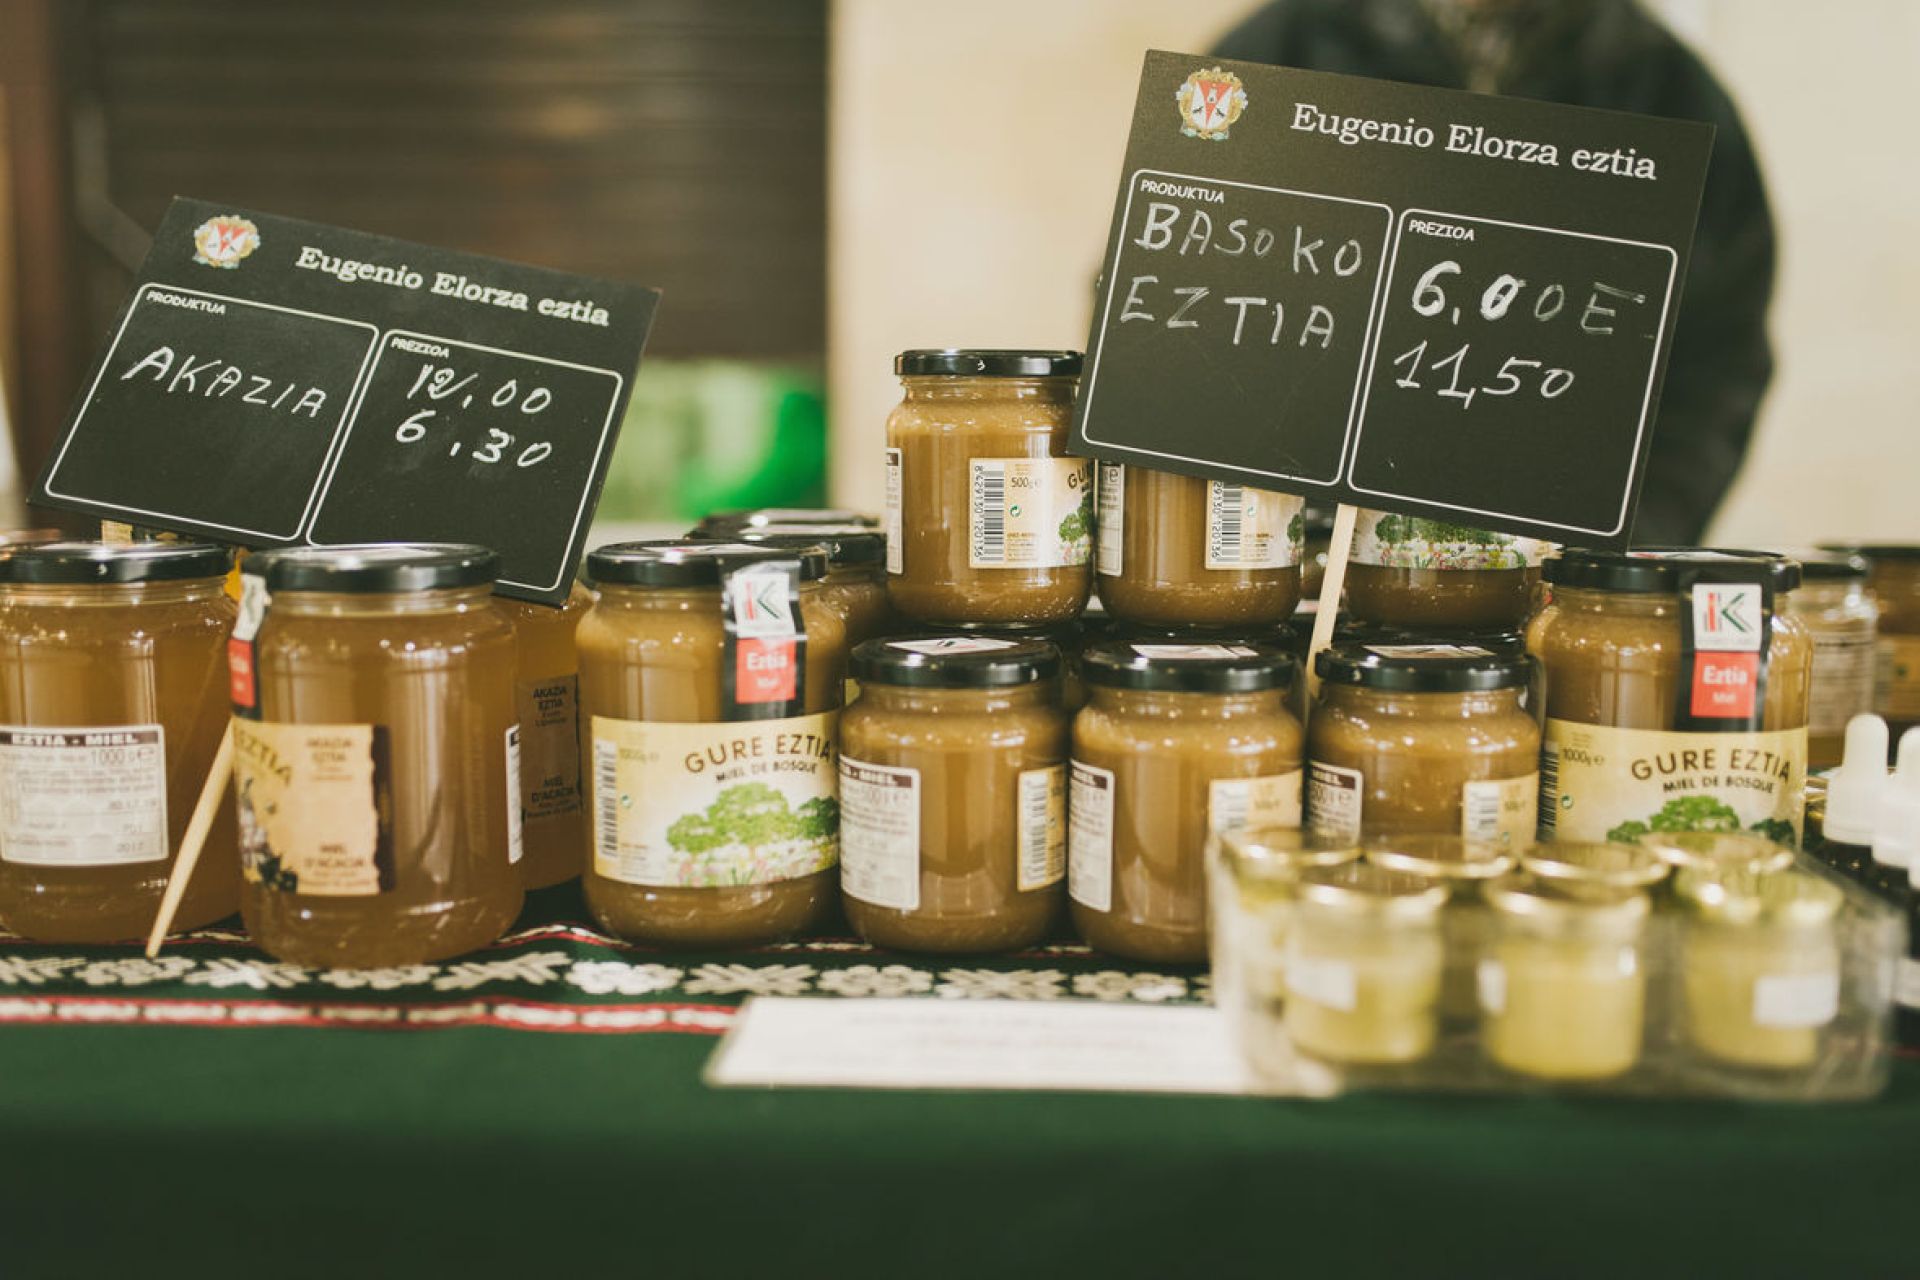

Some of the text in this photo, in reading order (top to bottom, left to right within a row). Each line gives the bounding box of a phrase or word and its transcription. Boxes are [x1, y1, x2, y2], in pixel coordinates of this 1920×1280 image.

[1290, 101, 1657, 180] Eugenio Elorza eztia
[1140, 179, 1225, 204] PRODUKTUA
[1408, 219, 1475, 242] PREZIOA
[295, 245, 610, 327] Eugenio Elorza eztia
[146, 290, 226, 315] PRODUKTUA
[1120, 275, 1335, 348] EZTIA
[391, 337, 449, 359] PREZIOA
[120, 346, 327, 418] AKAZIA
[1394, 340, 1575, 409] 11,50
[395, 409, 553, 467] 6,30
[746, 652, 788, 672] Eztia
[1703, 664, 1748, 686] Eztia
[84, 732, 138, 745] MIEL
[685, 734, 832, 773] GURE EZTIA
[1631, 749, 1791, 783] GURE EZTIA
[716, 760, 818, 783] MIEL DE BOSQUE
[1663, 776, 1775, 794] MIEL DE BOSQUE
